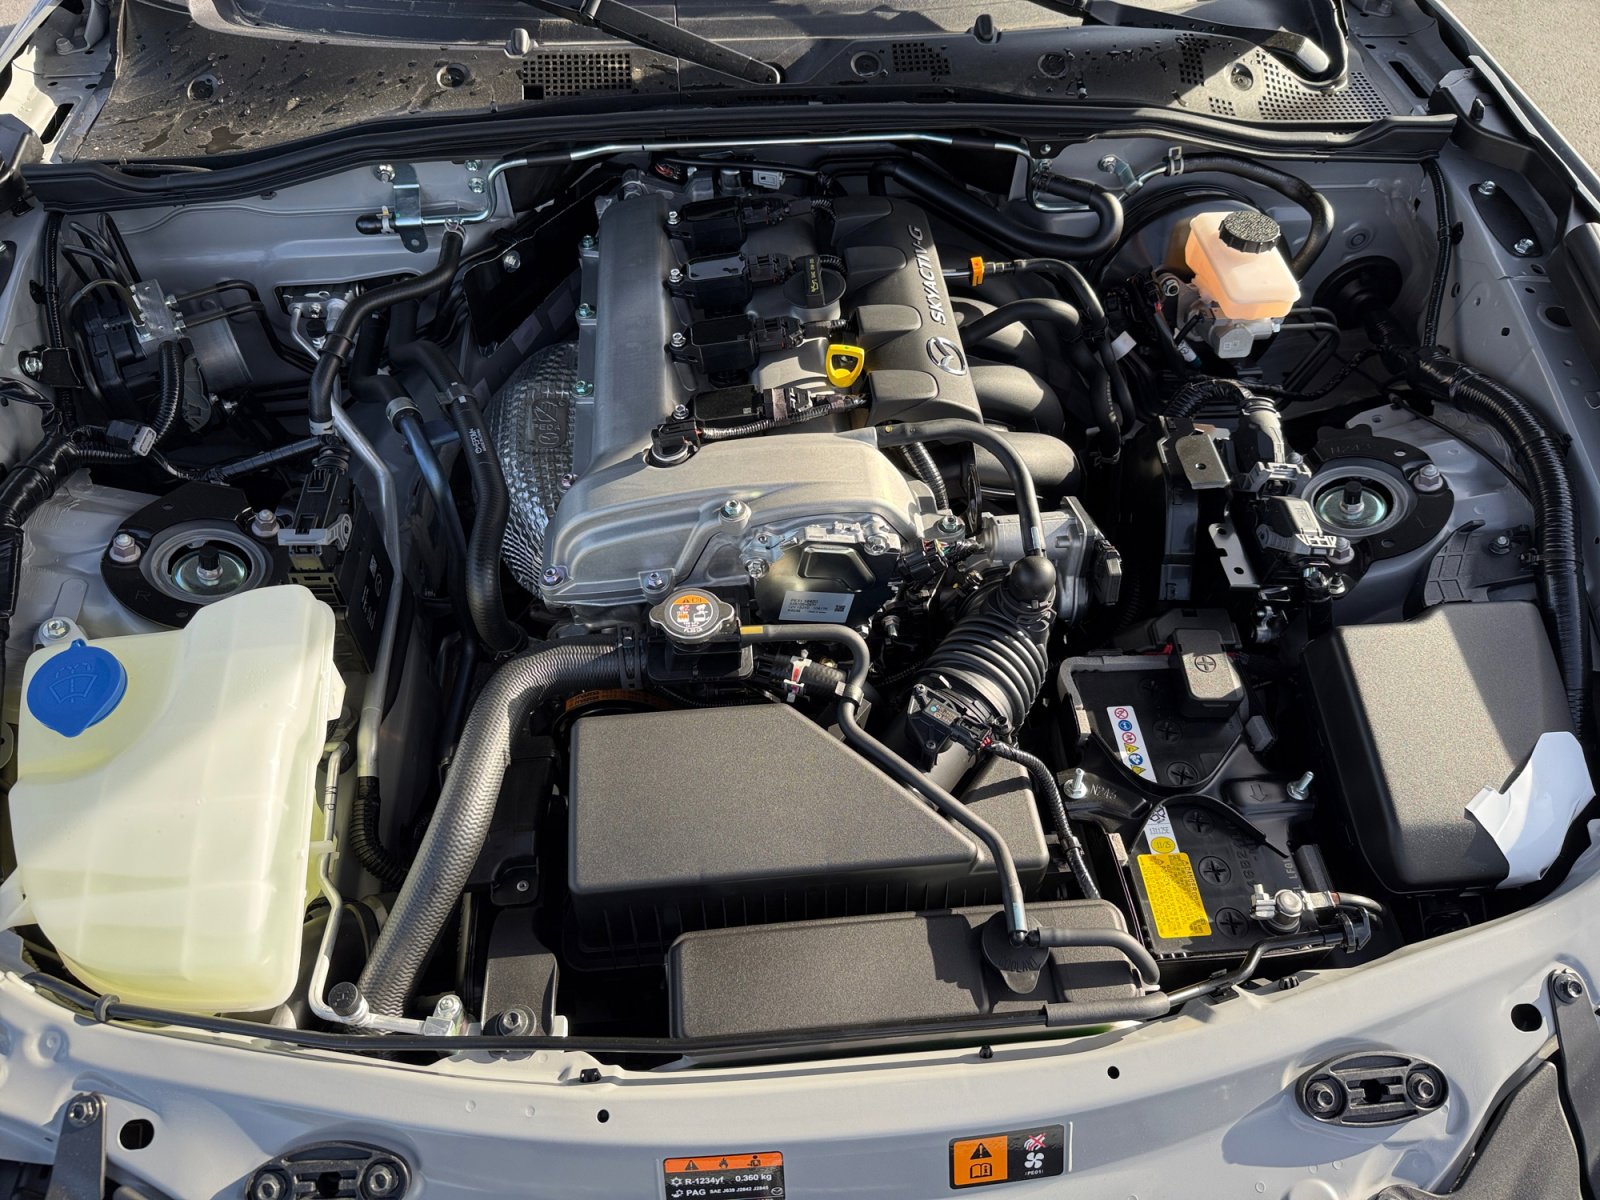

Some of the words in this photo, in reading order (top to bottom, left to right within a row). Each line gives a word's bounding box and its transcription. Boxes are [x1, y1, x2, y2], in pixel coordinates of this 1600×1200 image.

[908, 225, 946, 325] SKYACTIV-G
[685, 1176, 724, 1186] R-1234yf
[761, 1173, 772, 1181] kg
